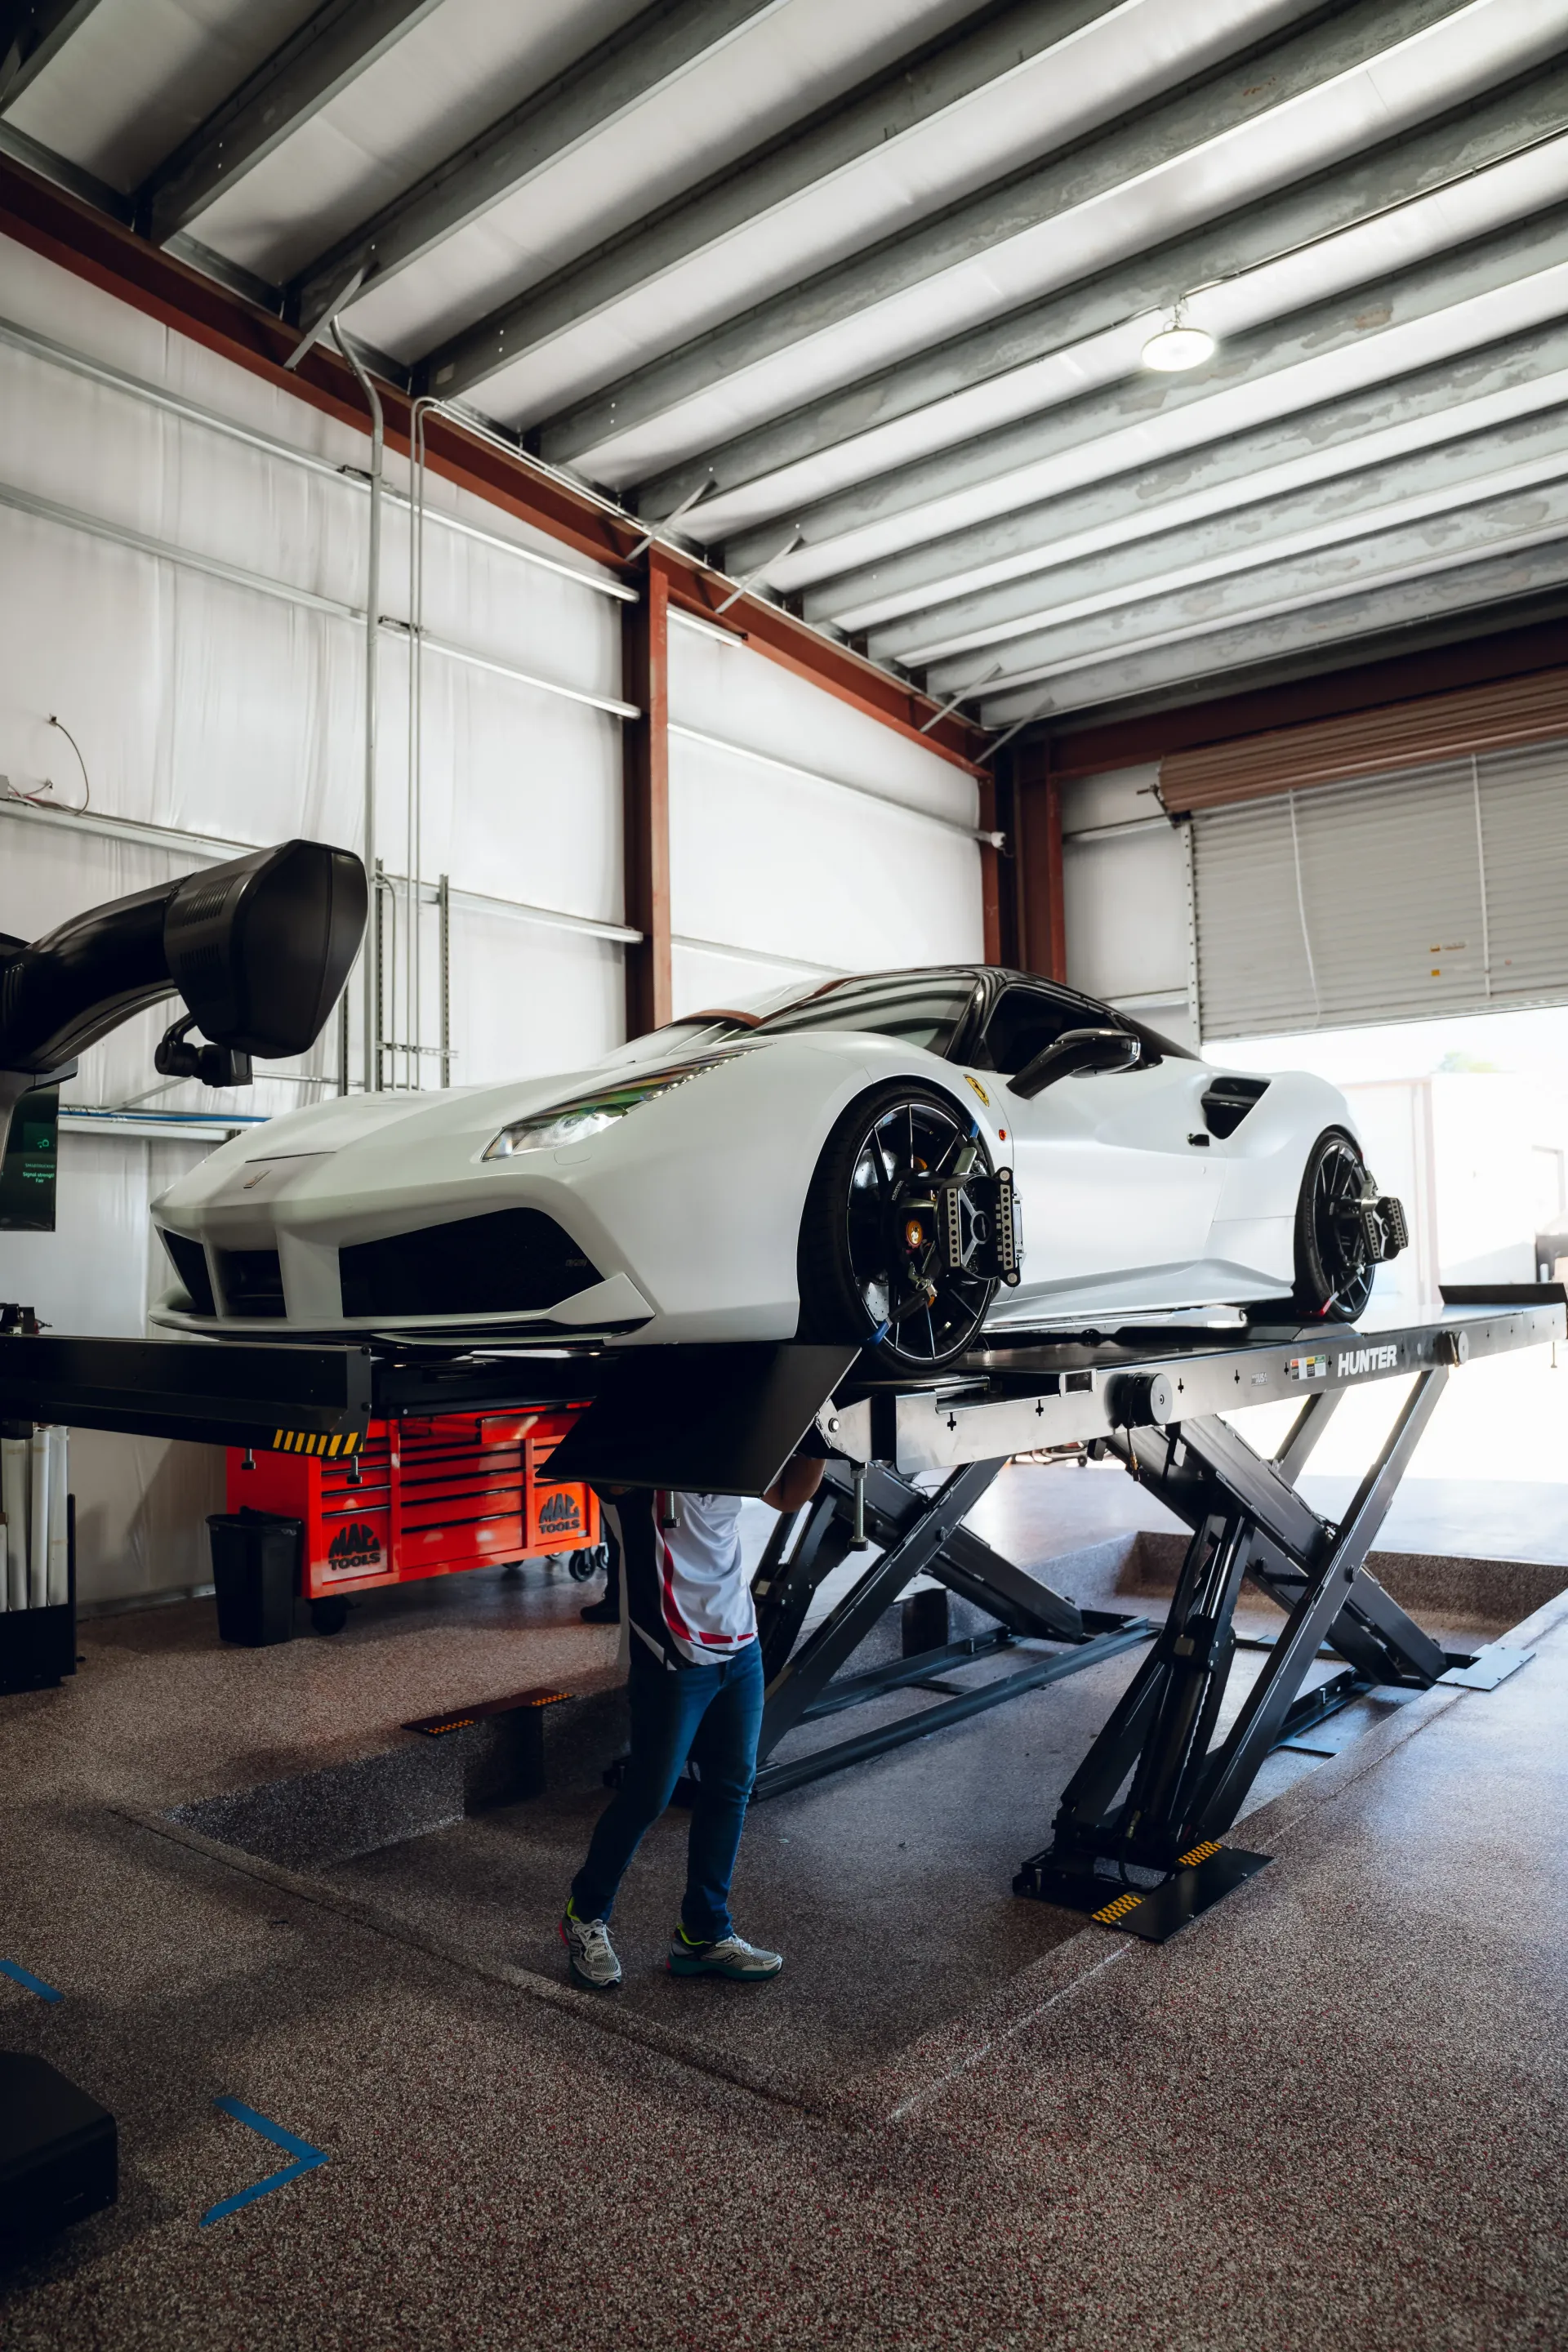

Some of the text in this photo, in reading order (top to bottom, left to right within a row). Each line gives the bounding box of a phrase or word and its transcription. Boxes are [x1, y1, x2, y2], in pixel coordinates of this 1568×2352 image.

[1338, 1345, 1397, 1377] HUNTER
[539, 1493, 580, 1524] MAC
[328, 1522, 381, 1559] MAC
[539, 1519, 580, 1535] TOOLS
[328, 1552, 381, 1570] TOOLS
